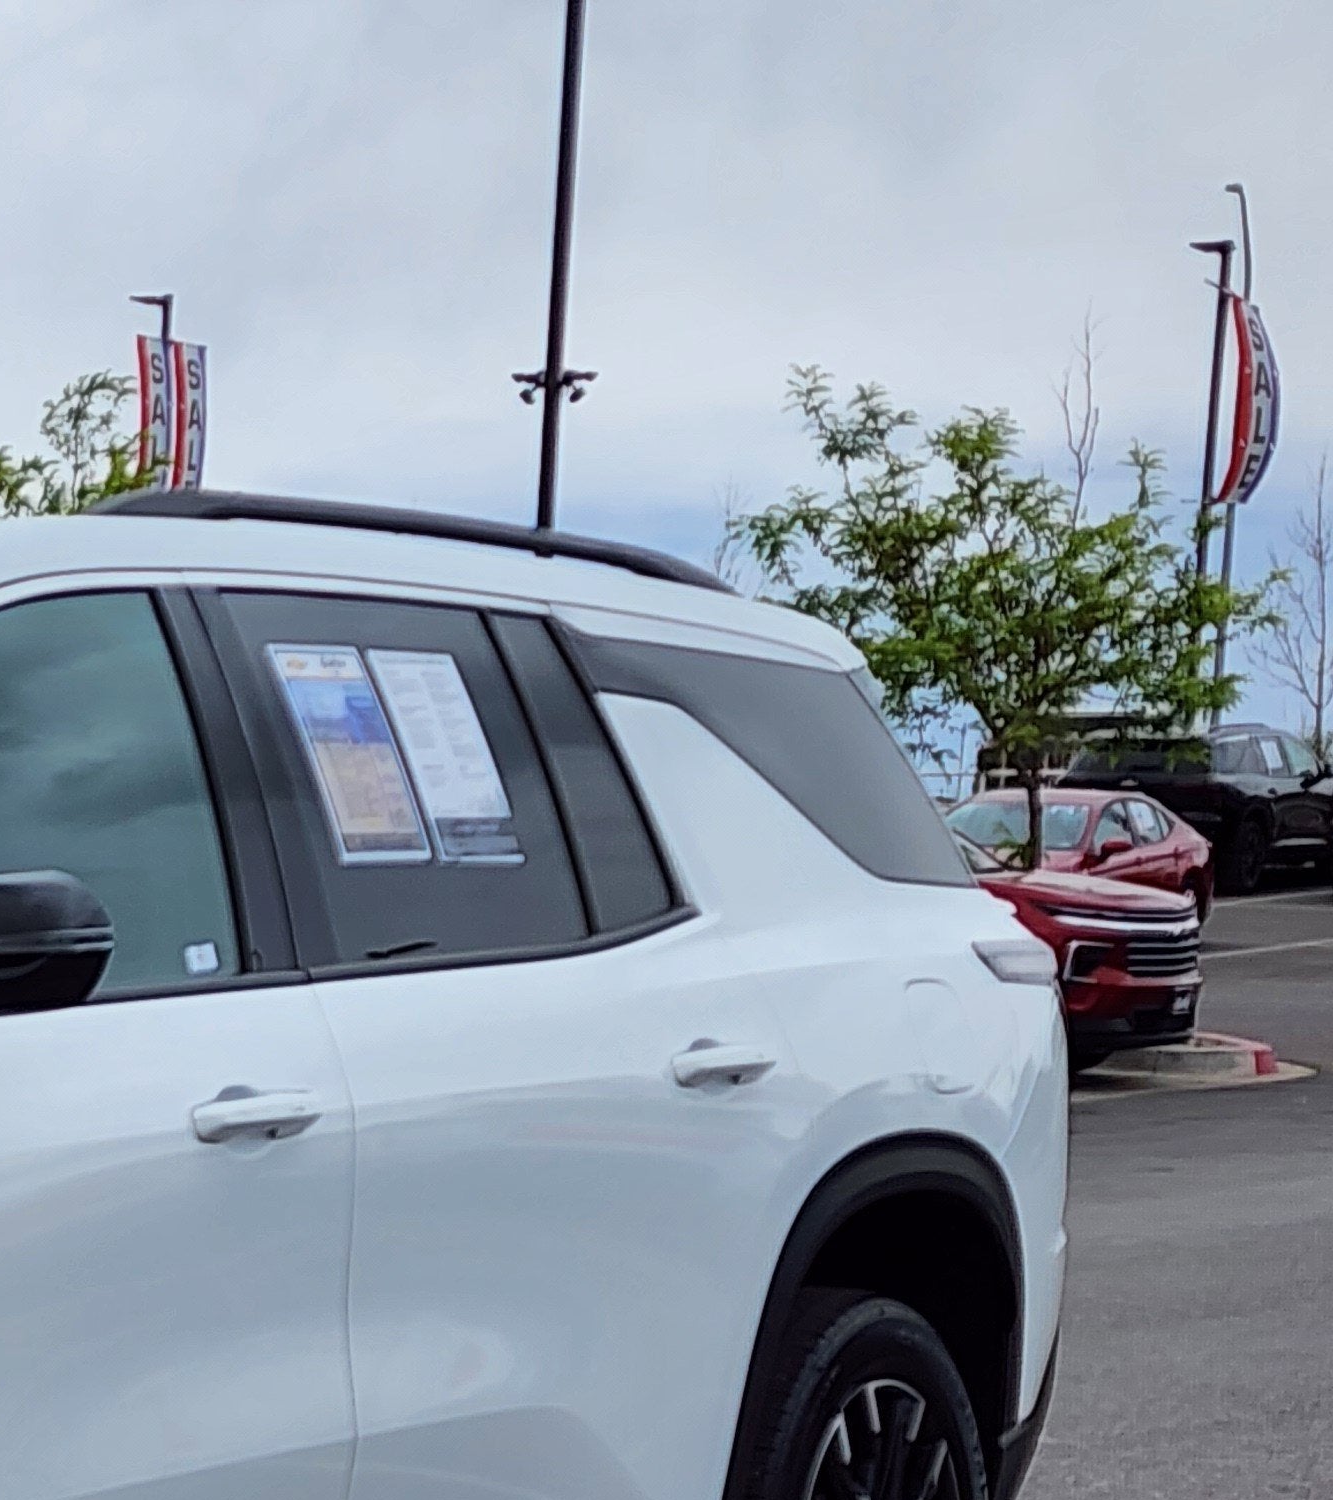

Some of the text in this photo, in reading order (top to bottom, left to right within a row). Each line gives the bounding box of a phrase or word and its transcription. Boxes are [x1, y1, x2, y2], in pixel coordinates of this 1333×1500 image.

[150, 352, 167, 472] SAL
[186, 359, 202, 491] SAL
[1237, 316, 1271, 492] SALE
